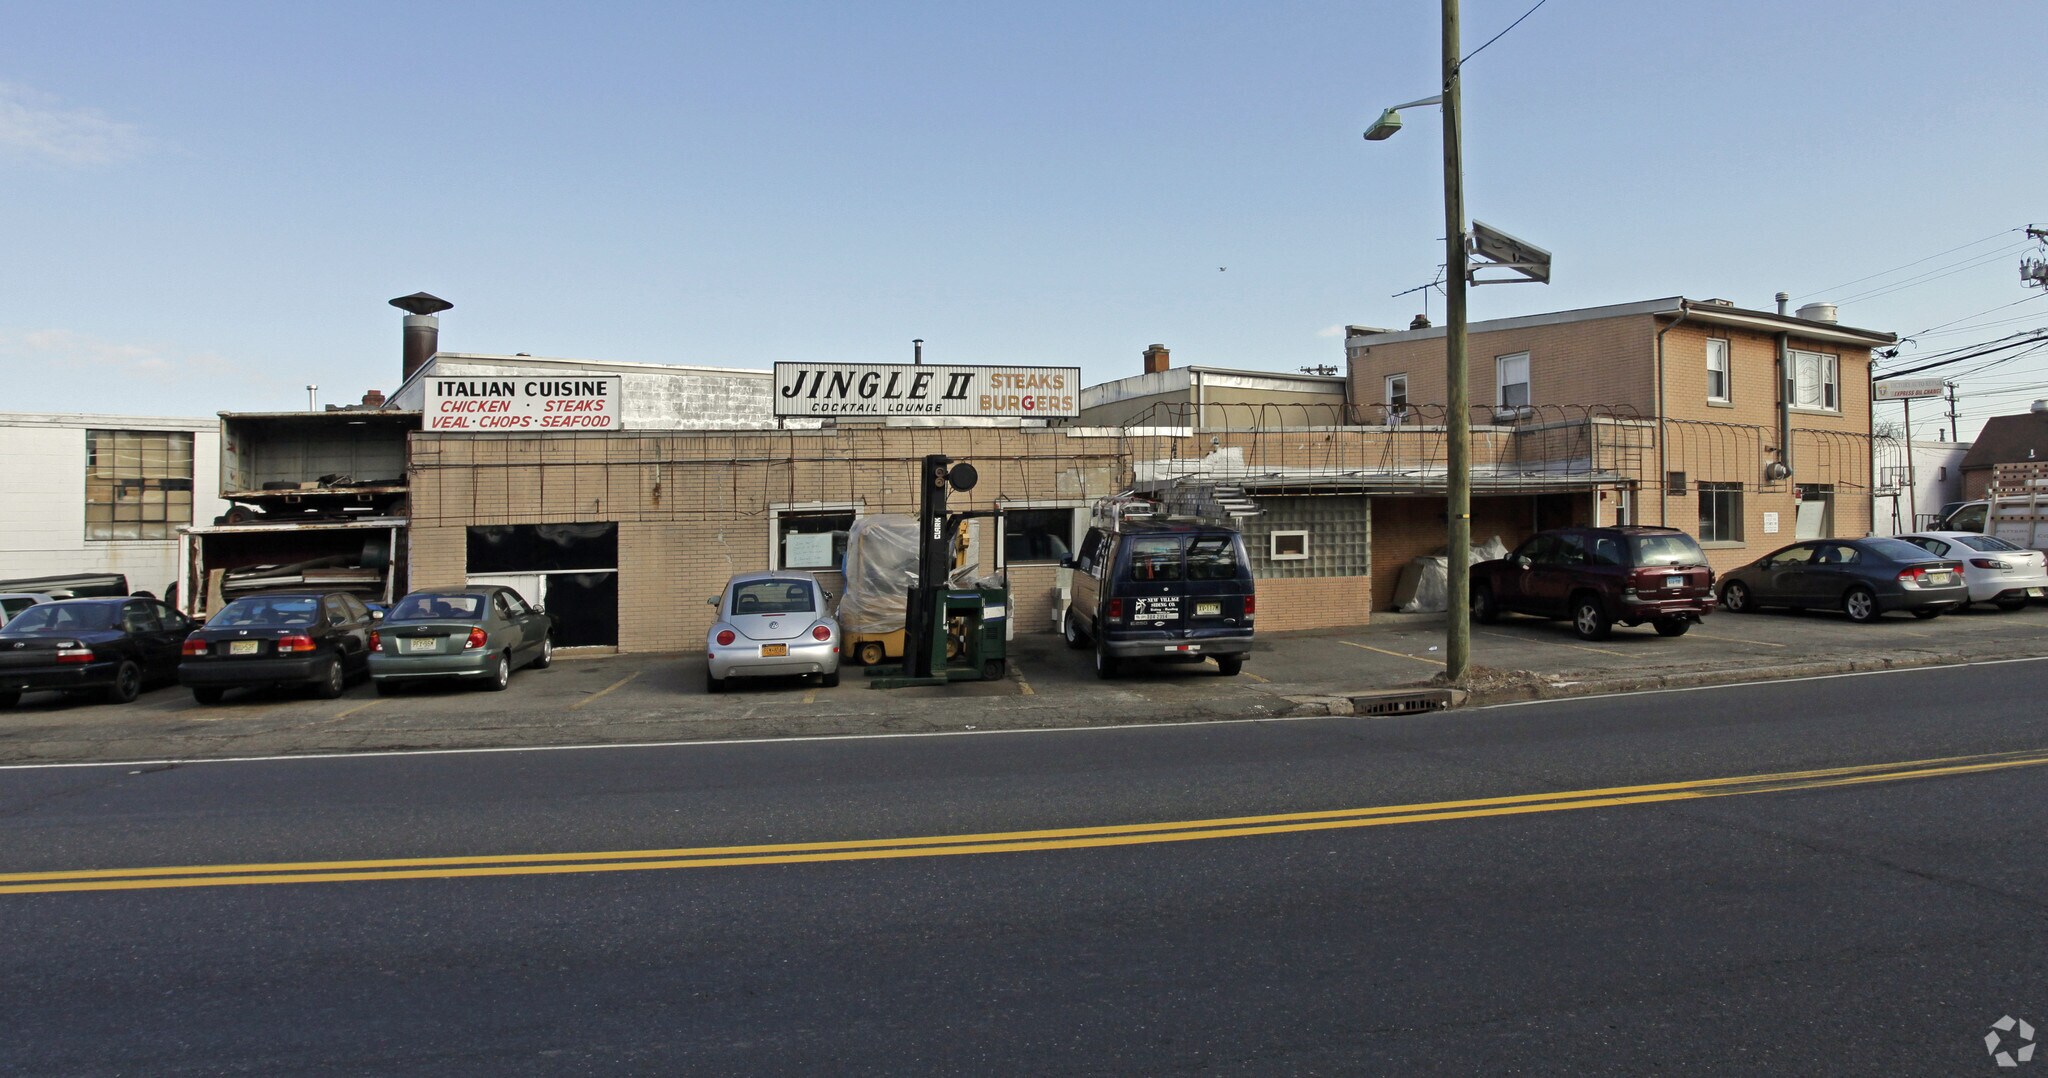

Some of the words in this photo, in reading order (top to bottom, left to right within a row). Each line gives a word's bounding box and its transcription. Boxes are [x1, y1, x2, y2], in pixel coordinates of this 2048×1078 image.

[437, 381, 515, 397] ITALIAN
[525, 380, 607, 397] CUISINE
[782, 370, 934, 399] JINGLE
[941, 372, 976, 400] II
[991, 373, 1065, 390] STEAKS
[1894, 389, 1914, 397] EXPRESS
[440, 400, 511, 413] CHICKEN
[544, 399, 606, 412] STEAKS
[811, 403, 878, 412] COCKTAIL
[888, 403, 942, 412] LOUNGE
[980, 395, 1073, 412] BURGERS
[432, 416, 470, 429] VEAL
[479, 415, 532, 428] CHOPS
[540, 415, 611, 428] SEAFOOD
[934, 517, 942, 539] CLARK
